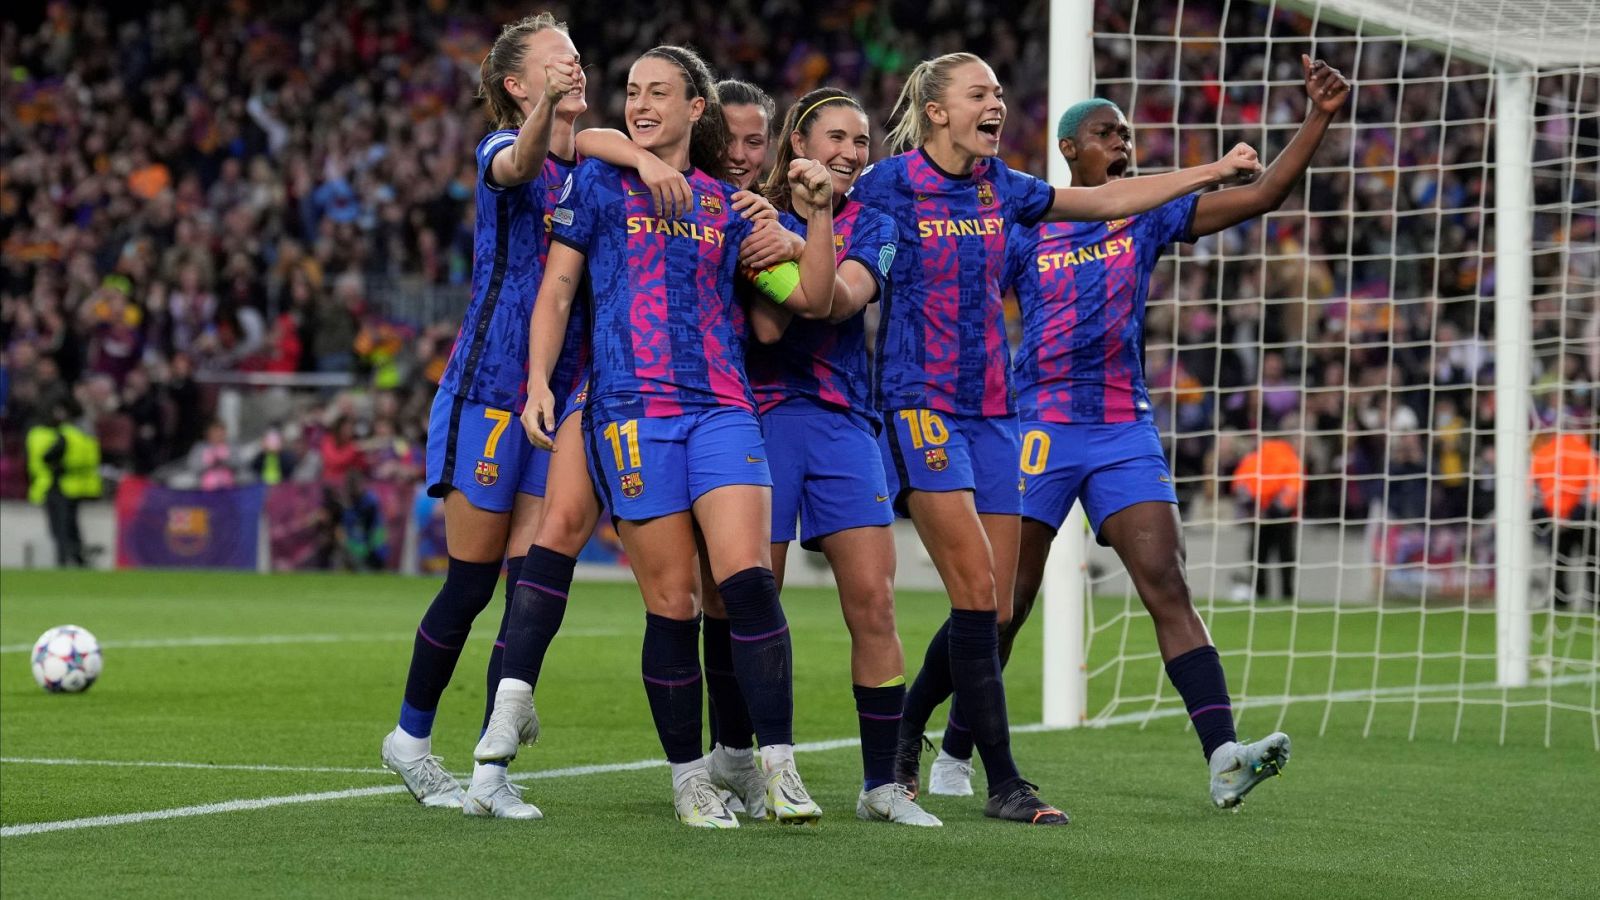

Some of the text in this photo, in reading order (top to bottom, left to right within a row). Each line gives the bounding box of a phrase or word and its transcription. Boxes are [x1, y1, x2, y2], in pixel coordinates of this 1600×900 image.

[627, 216, 726, 248] STANLEY
[918, 217, 1004, 238] STANLEY
[1037, 237, 1133, 272] STANLEY
[483, 408, 512, 459] 7
[604, 419, 642, 471] 11
[900, 409, 949, 449] 16
[1020, 430, 1051, 475] 0
